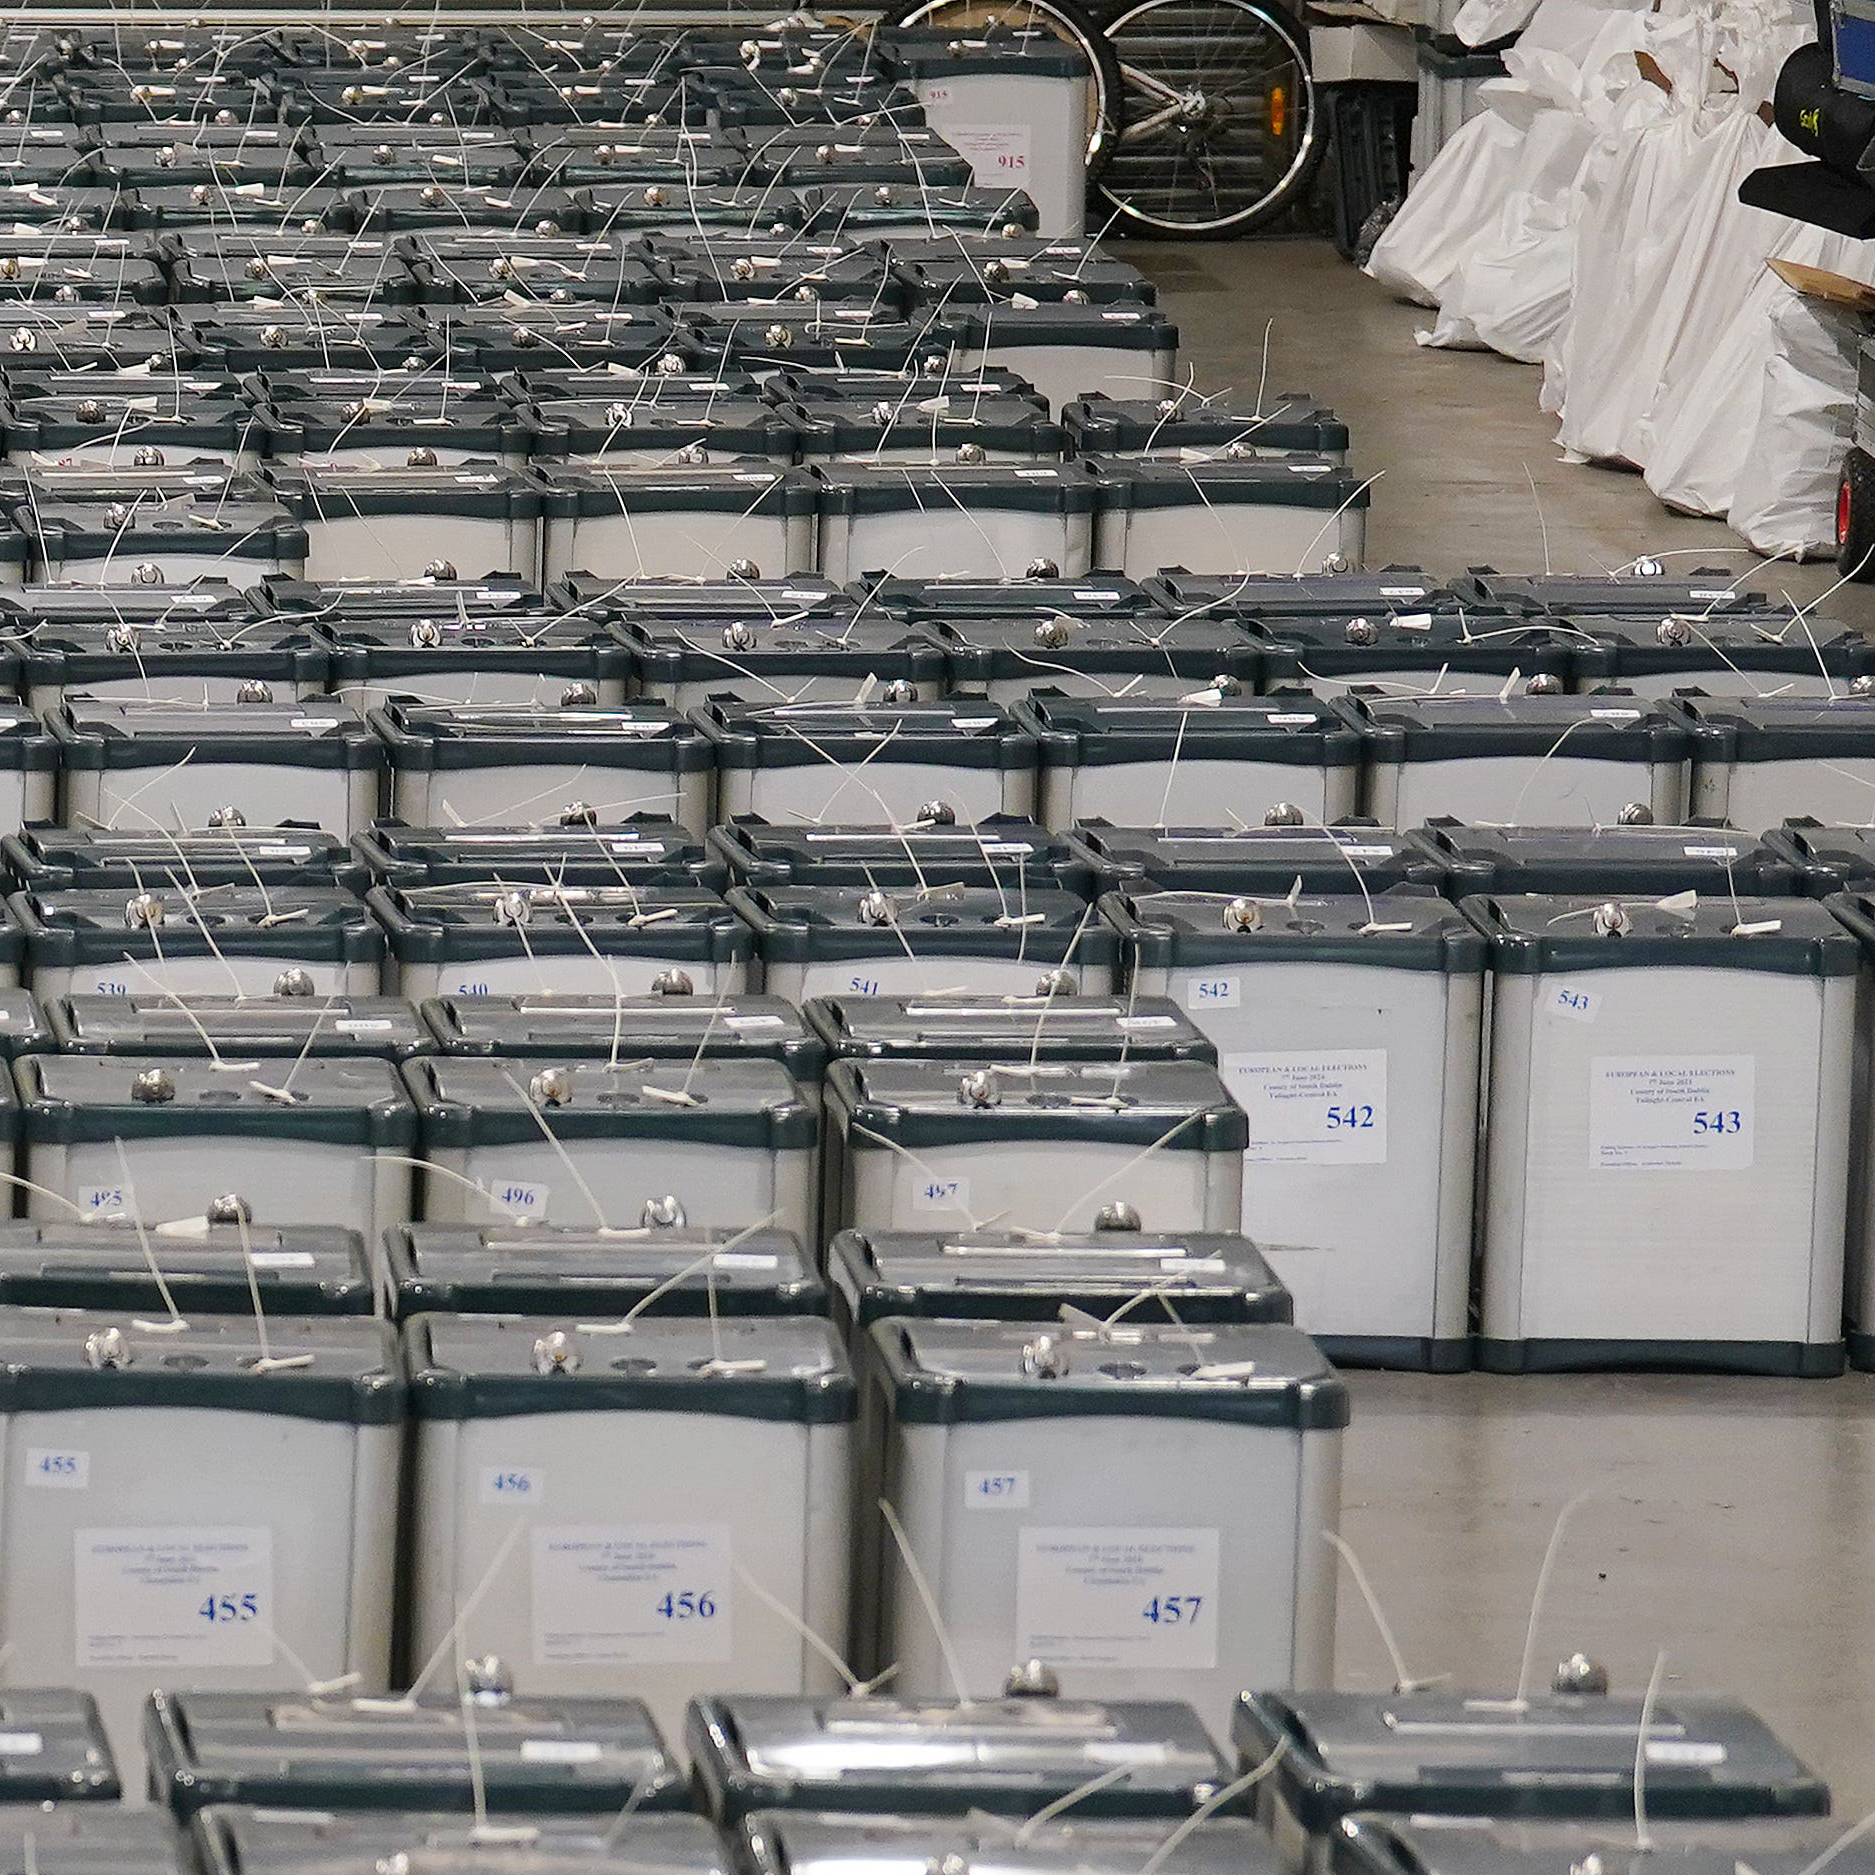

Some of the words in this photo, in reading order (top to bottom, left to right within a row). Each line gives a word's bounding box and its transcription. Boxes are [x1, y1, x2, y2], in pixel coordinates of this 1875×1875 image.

[997, 155, 1025, 170] 915
[849, 976, 882, 995] 541
[1198, 976, 1230, 997] 542
[1557, 987, 1591, 1009] 543
[1325, 1104, 1375, 1131] 542
[1692, 1109, 1742, 1136] 543
[500, 1186, 536, 1206] 496
[39, 1455, 77, 1474] 455
[493, 1473, 531, 1493] 456
[979, 1476, 1017, 1496] 457
[198, 1593, 259, 1623] 455
[656, 1590, 717, 1620] 456
[1142, 1595, 1203, 1625] 457
